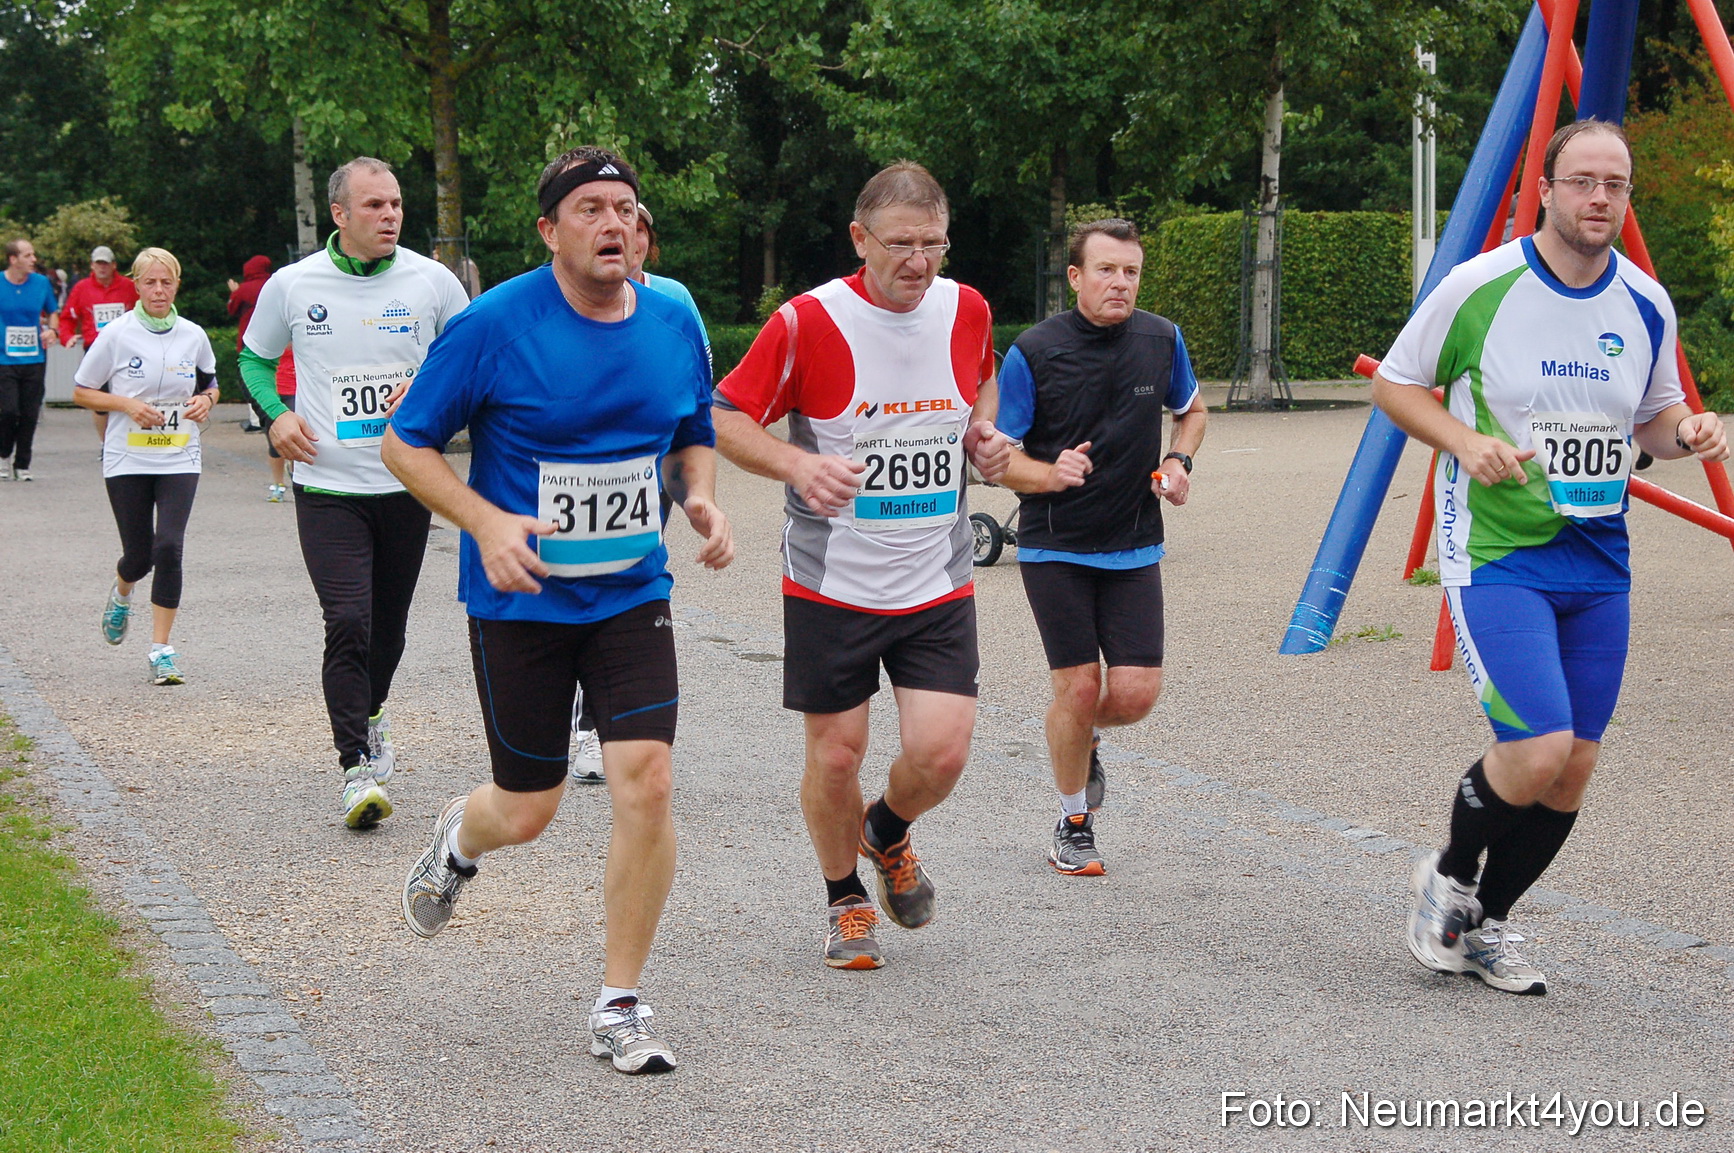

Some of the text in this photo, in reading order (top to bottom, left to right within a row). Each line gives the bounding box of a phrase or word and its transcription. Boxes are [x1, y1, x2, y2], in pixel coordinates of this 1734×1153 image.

[332, 371, 403, 384] PARTL Neumarkt
[1541, 360, 1610, 381] Mathias
[341, 383, 402, 417] 303
[883, 399, 958, 415] KLEBL
[361, 420, 391, 435] Mart
[1532, 422, 1567, 432] PARTL
[147, 436, 172, 446] Astrid
[855, 436, 943, 450] PARTL Neumarkt
[1545, 438, 1624, 477] 2805
[864, 450, 951, 491] 2698
[542, 472, 641, 487] PARTL Neumarkt
[1565, 487, 1606, 503] athias
[552, 486, 650, 533] 3124
[880, 498, 937, 516] Manfred
